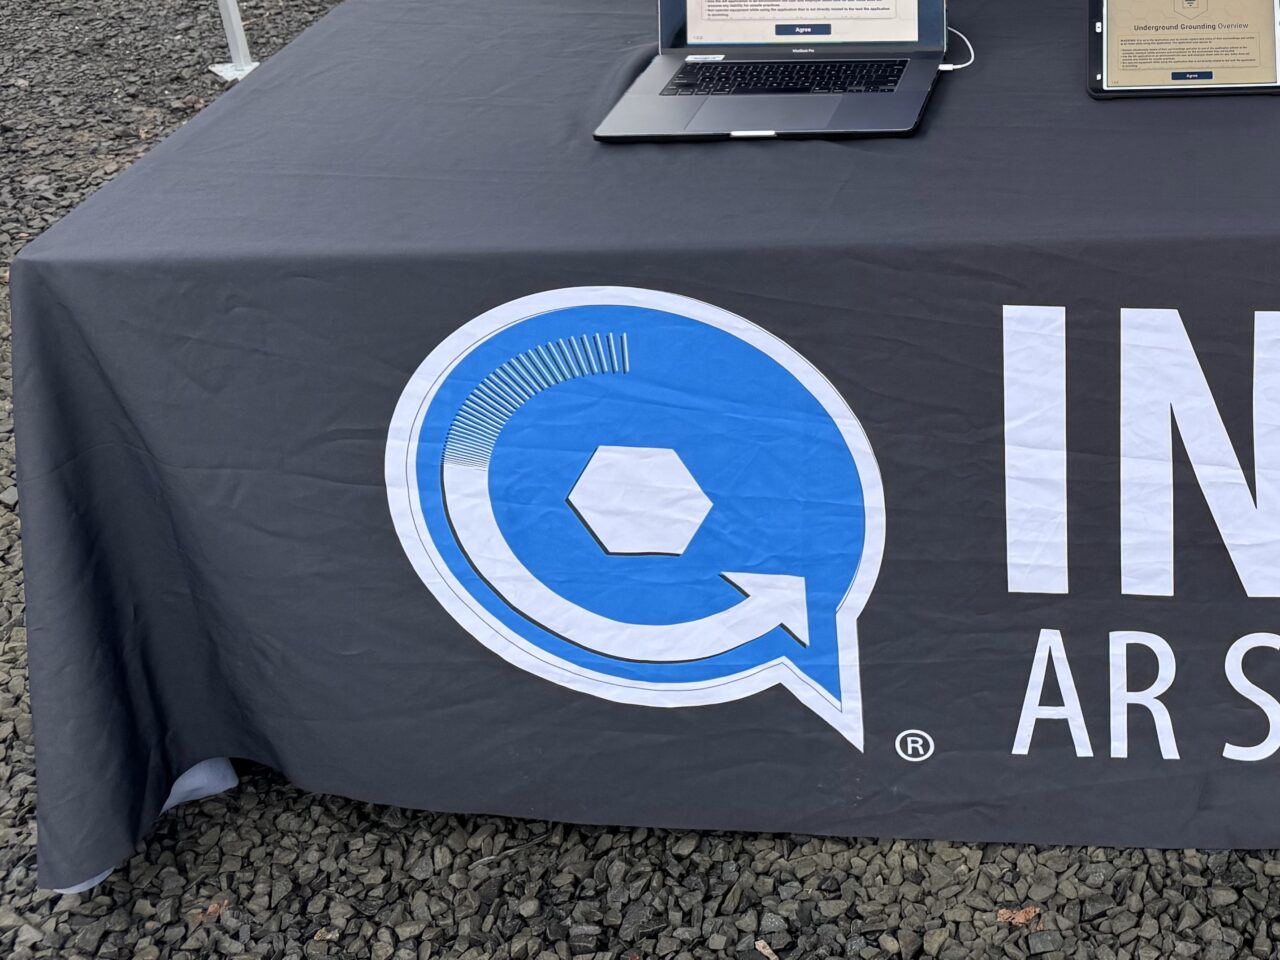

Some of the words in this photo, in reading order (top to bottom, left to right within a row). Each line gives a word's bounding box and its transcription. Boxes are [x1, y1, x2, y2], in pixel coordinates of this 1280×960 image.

[1134, 24, 1179, 32] Underground
[1180, 23, 1216, 31] Grounding
[1011, 628, 1181, 760] AR
